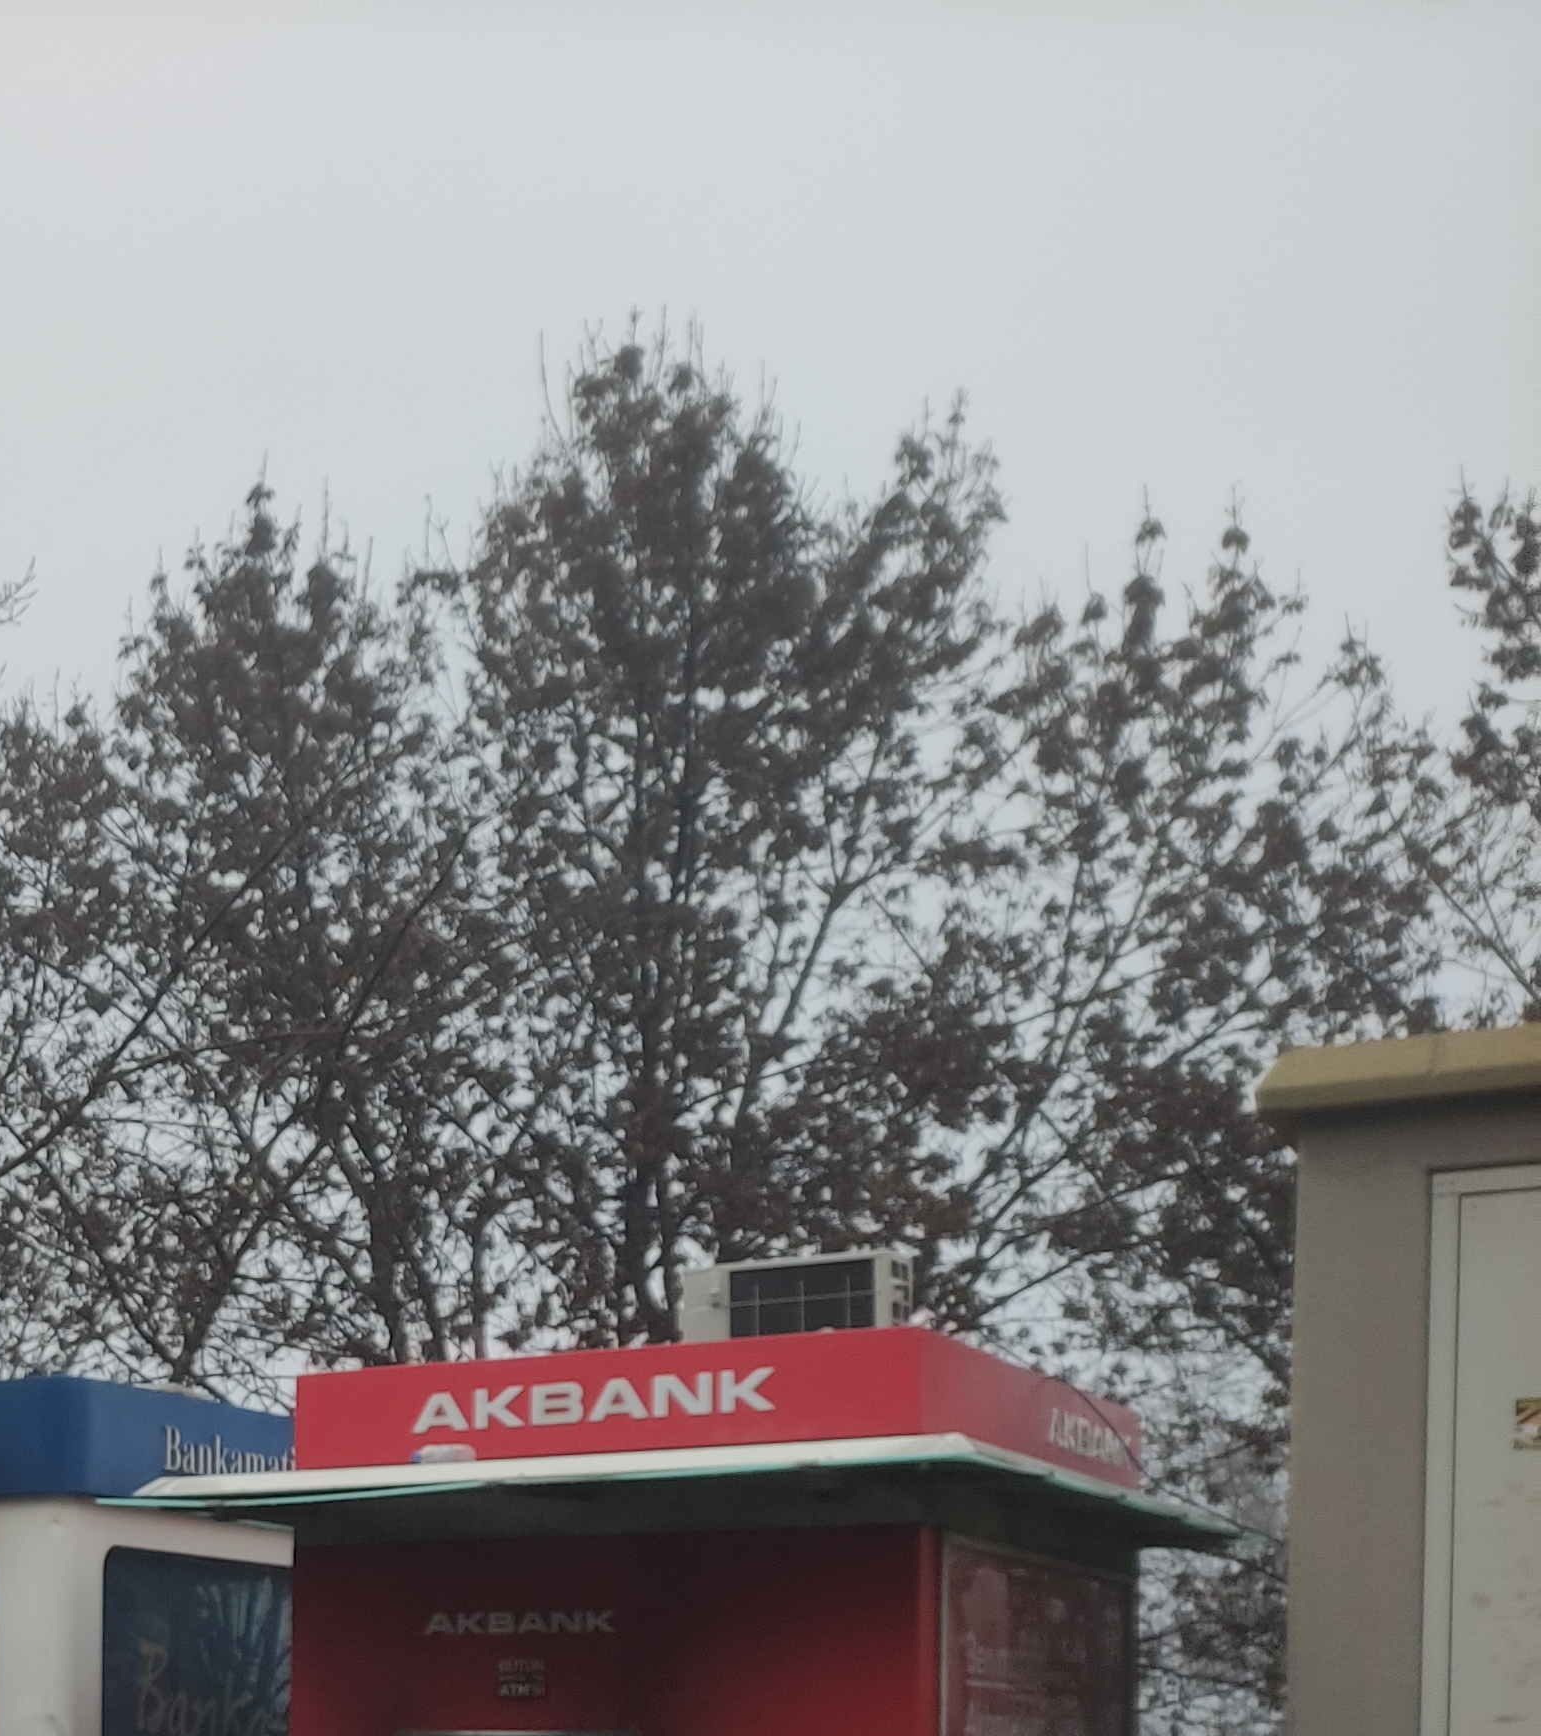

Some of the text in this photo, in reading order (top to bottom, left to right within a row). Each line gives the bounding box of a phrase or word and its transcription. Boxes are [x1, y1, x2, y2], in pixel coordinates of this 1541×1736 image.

[412, 1366, 777, 1434] AKBANK
[164, 1425, 296, 1475] Bankamati
[1048, 1407, 1133, 1471] AKBANK
[424, 1609, 616, 1636] AKBANK
